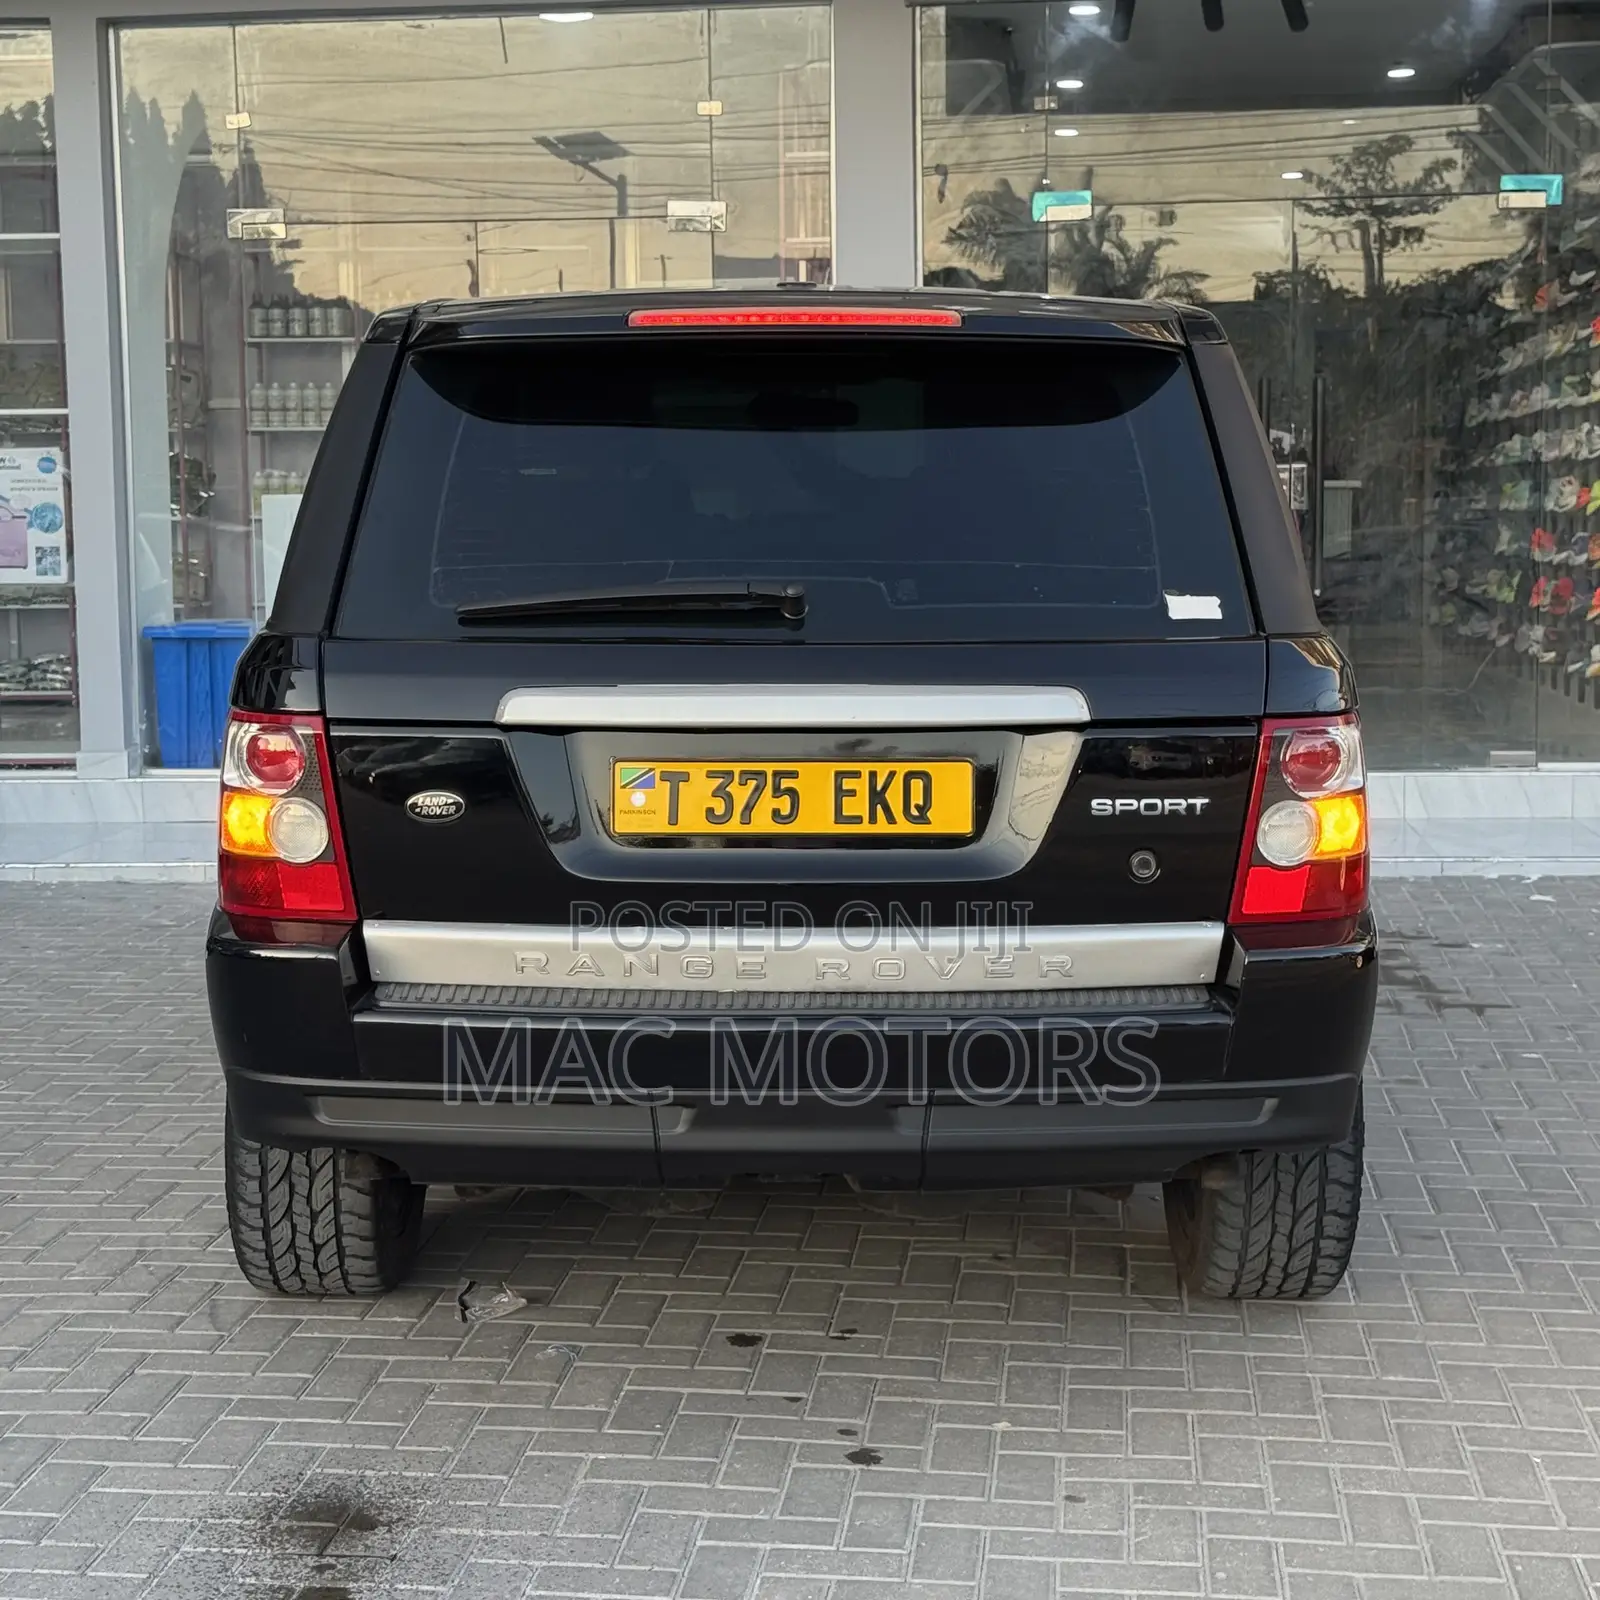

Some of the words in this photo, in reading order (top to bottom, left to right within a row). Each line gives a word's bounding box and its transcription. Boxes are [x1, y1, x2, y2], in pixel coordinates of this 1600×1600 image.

[418, 796, 447, 806] LAND
[660, 770, 690, 825] T
[706, 769, 800, 825] 375
[834, 769, 932, 825] EKQ
[421, 805, 456, 815] ROVER
[1091, 798, 1210, 815] SPORT
[514, 951, 767, 979] RANGE
[815, 955, 1074, 980] ROVER
